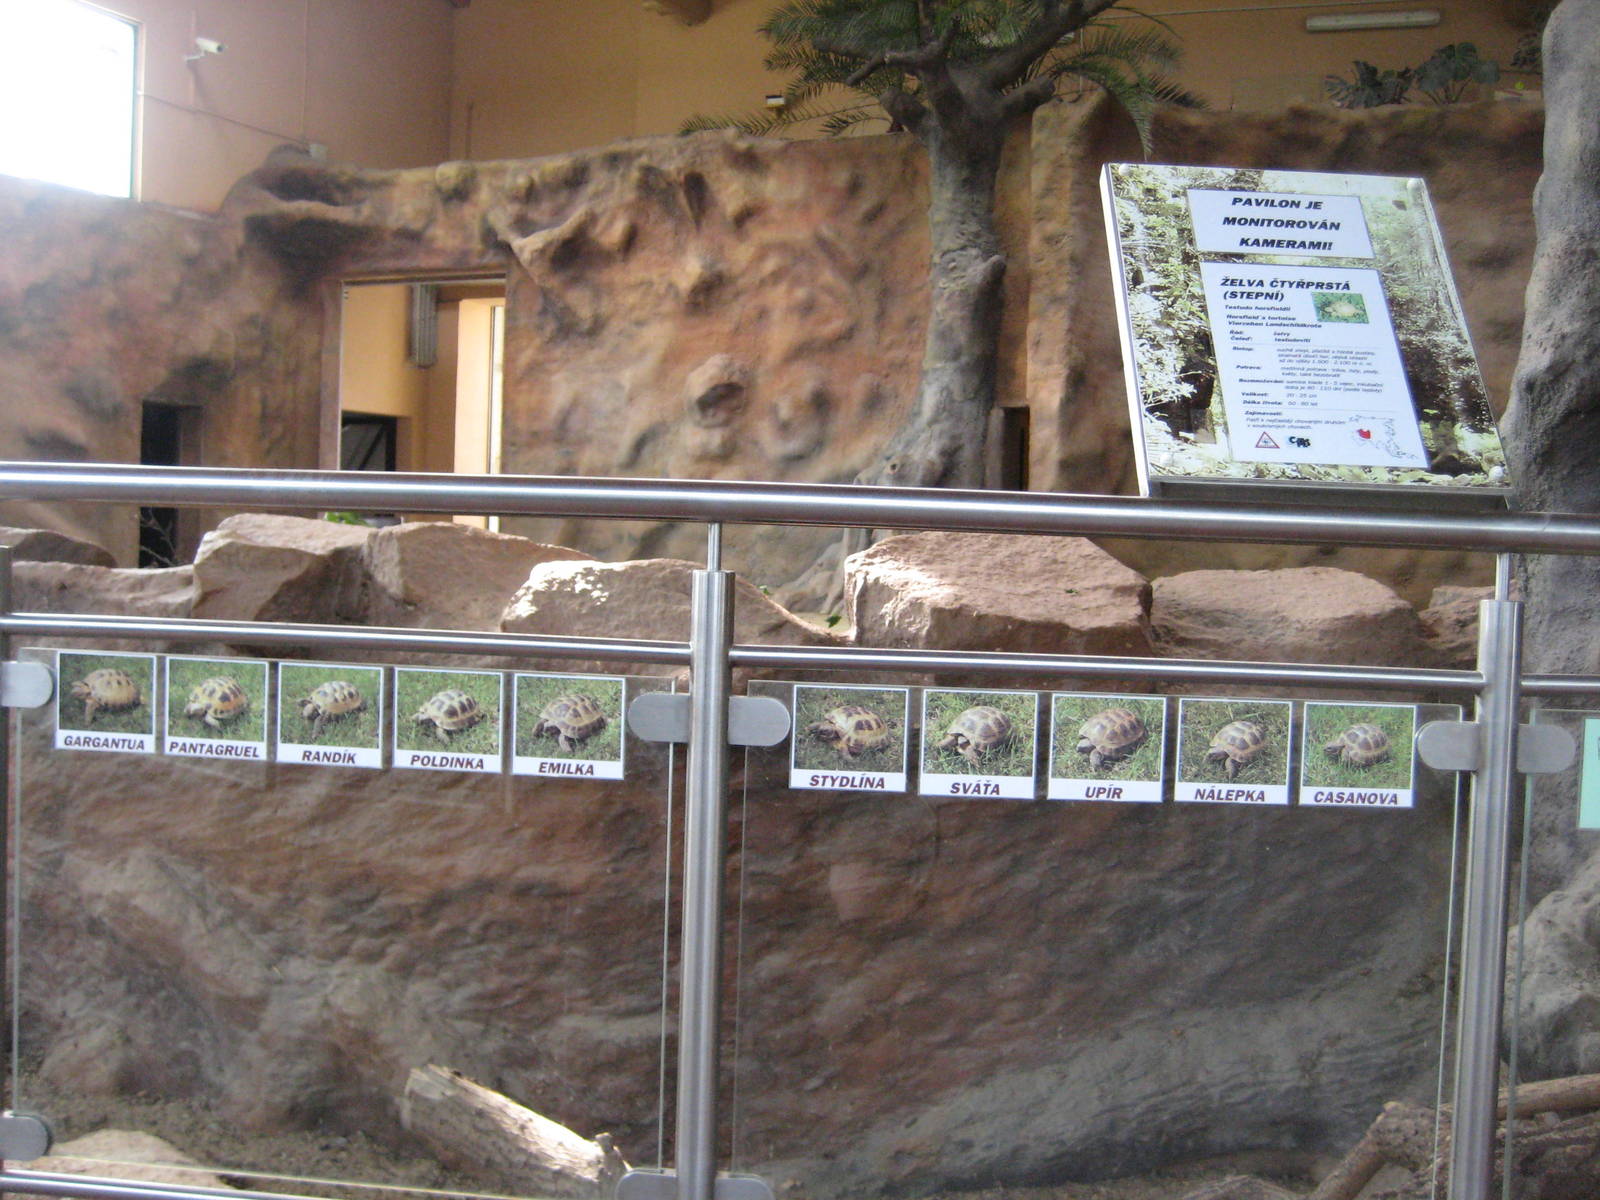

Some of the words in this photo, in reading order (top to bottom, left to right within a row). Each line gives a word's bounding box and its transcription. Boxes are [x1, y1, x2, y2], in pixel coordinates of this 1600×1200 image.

[1231, 197, 1302, 209] PAVILON
[1304, 200, 1323, 210] JE
[1222, 216, 1341, 231] MONITOROVÁN
[1238, 238, 1333, 251] KAMERAMI!
[1220, 276, 1266, 288] ŽELVA
[1269, 277, 1351, 292] ČTYŘPRSTÁ
[1223, 290, 1285, 302] (STEPNÍ)
[63, 734, 145, 752] GARGANTUA
[168, 741, 261, 759] PANTAGRUEL
[301, 748, 358, 765] RANDÍK
[409, 753, 486, 771] POLDINKA
[537, 761, 596, 777] EMILKA
[808, 771, 887, 789] STYDLÍNA
[948, 778, 1002, 797] SVÁŤA
[1083, 782, 1125, 801] UPÍR
[1193, 783, 1267, 803] NÁLEPKA
[1312, 789, 1400, 807] CASANOVA
